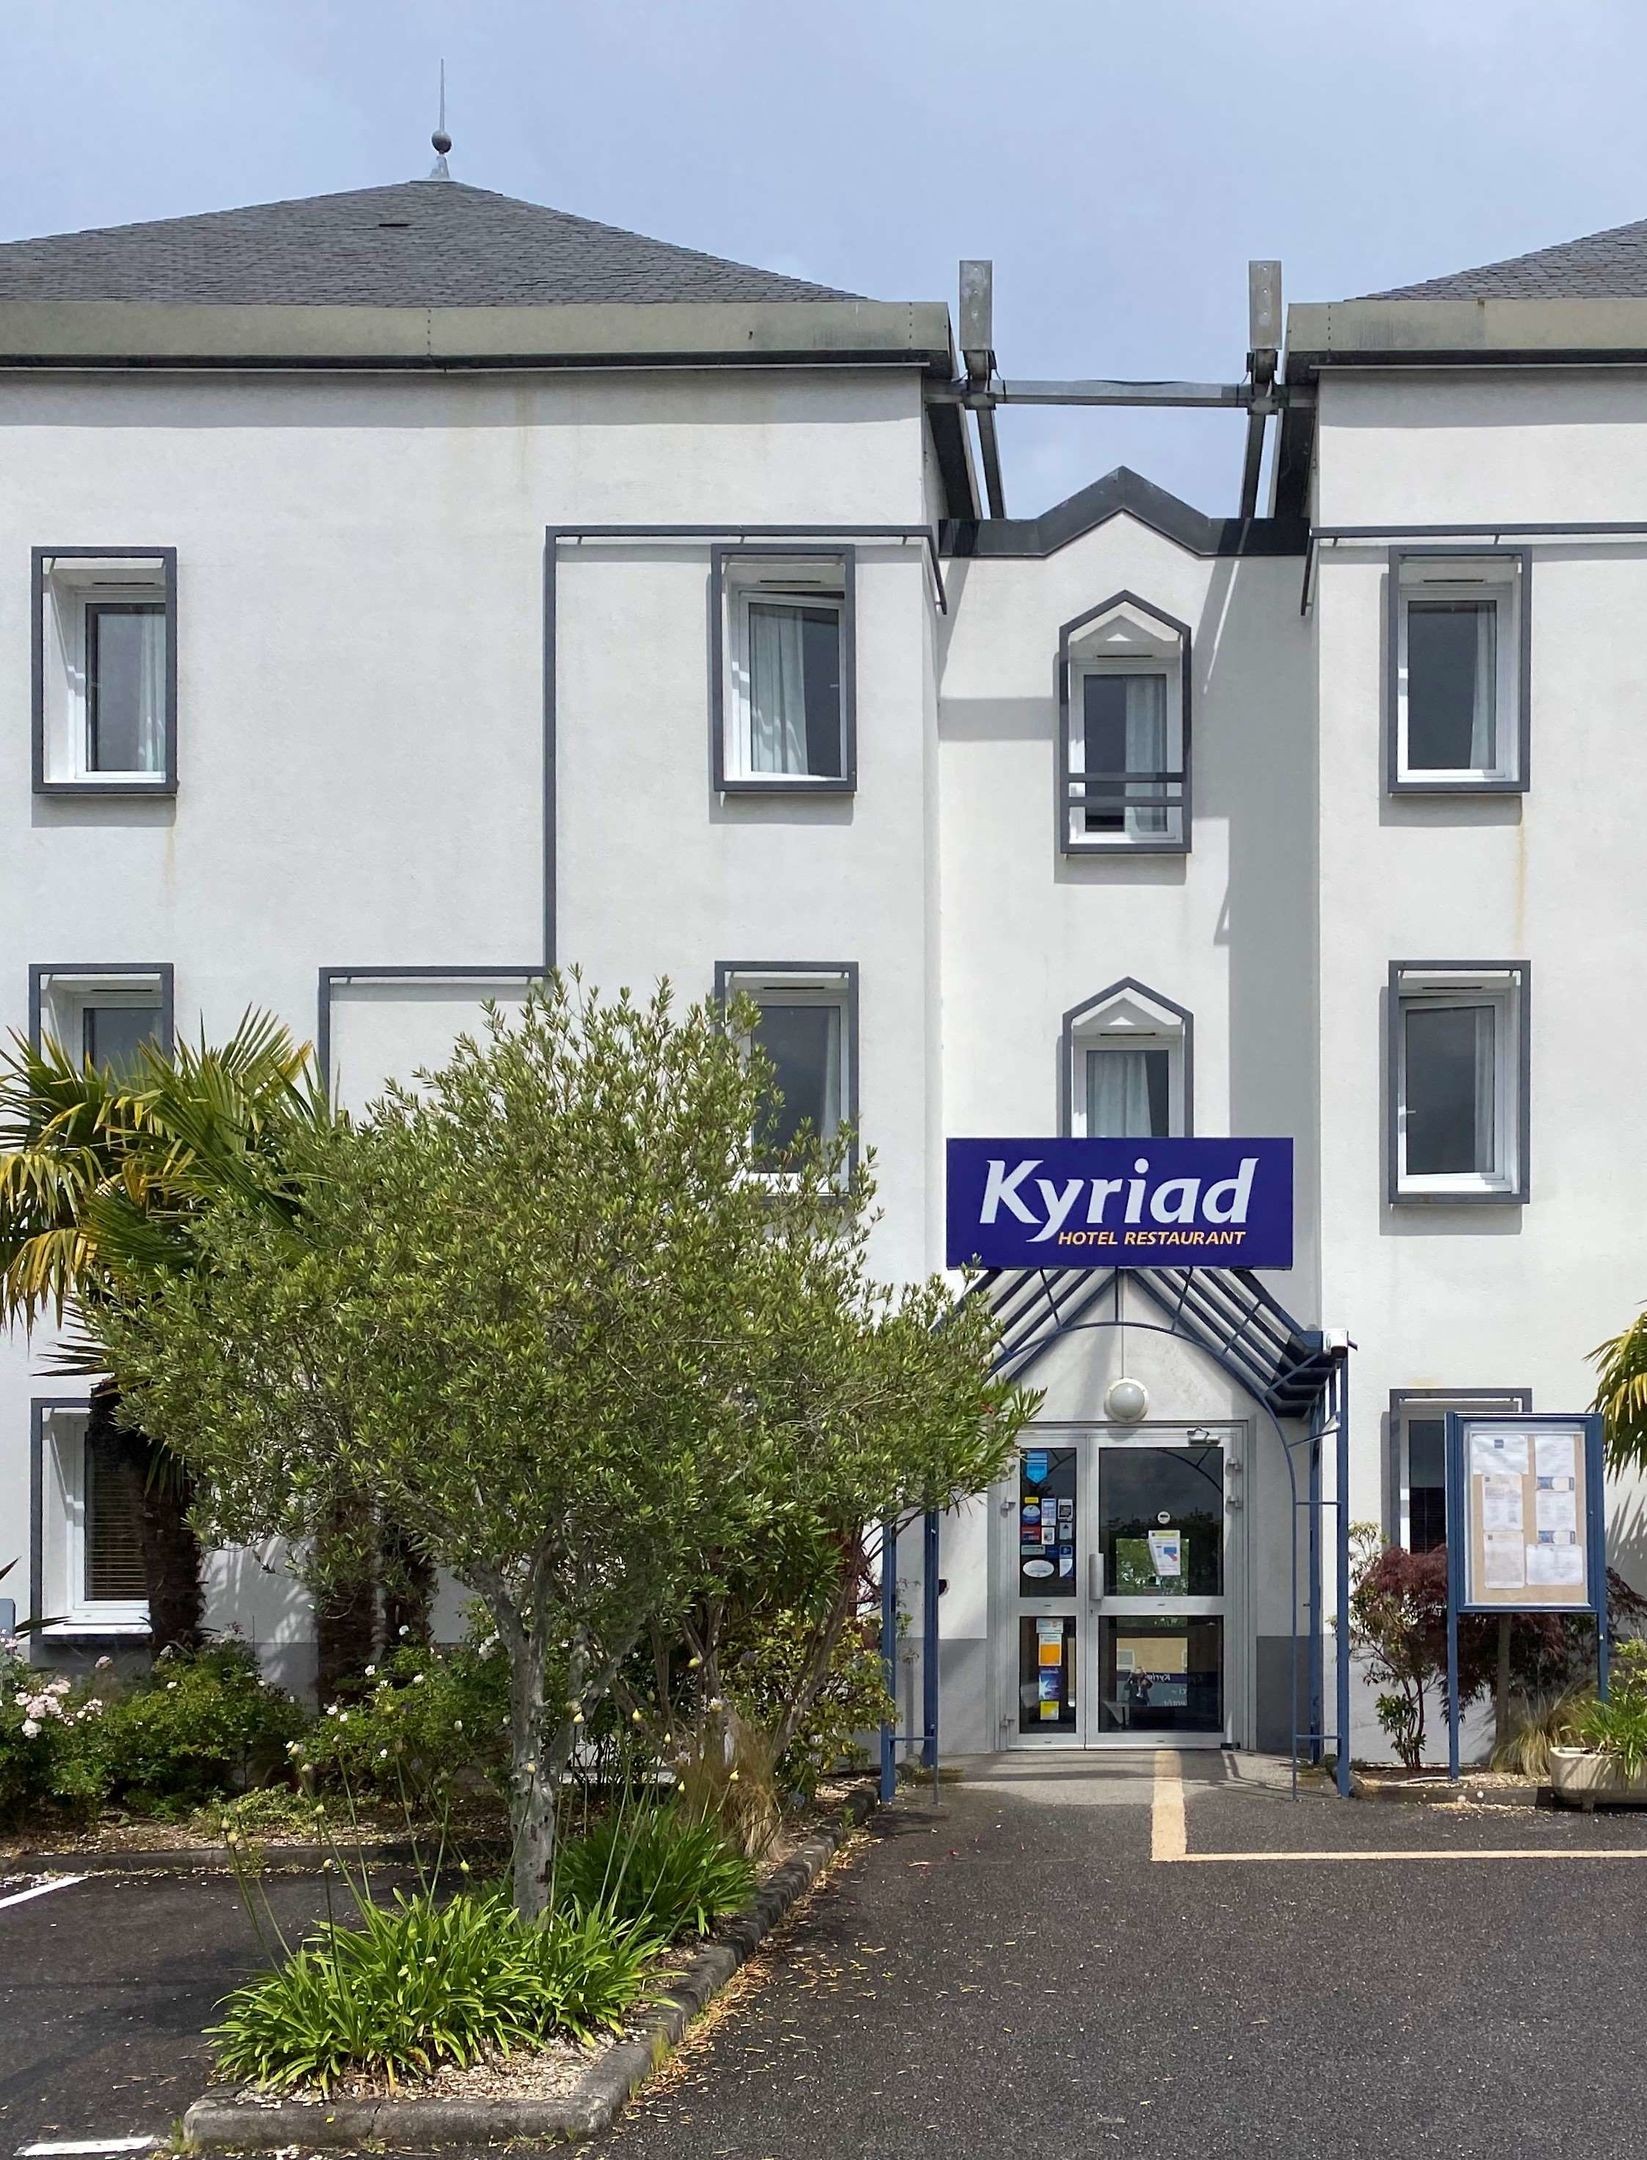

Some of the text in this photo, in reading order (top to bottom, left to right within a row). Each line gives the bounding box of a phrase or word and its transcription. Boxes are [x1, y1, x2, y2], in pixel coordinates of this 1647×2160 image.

[979, 1158, 1259, 1242] Kyriad
[1058, 1231, 1246, 1245] HOTEL RESTAURANT
